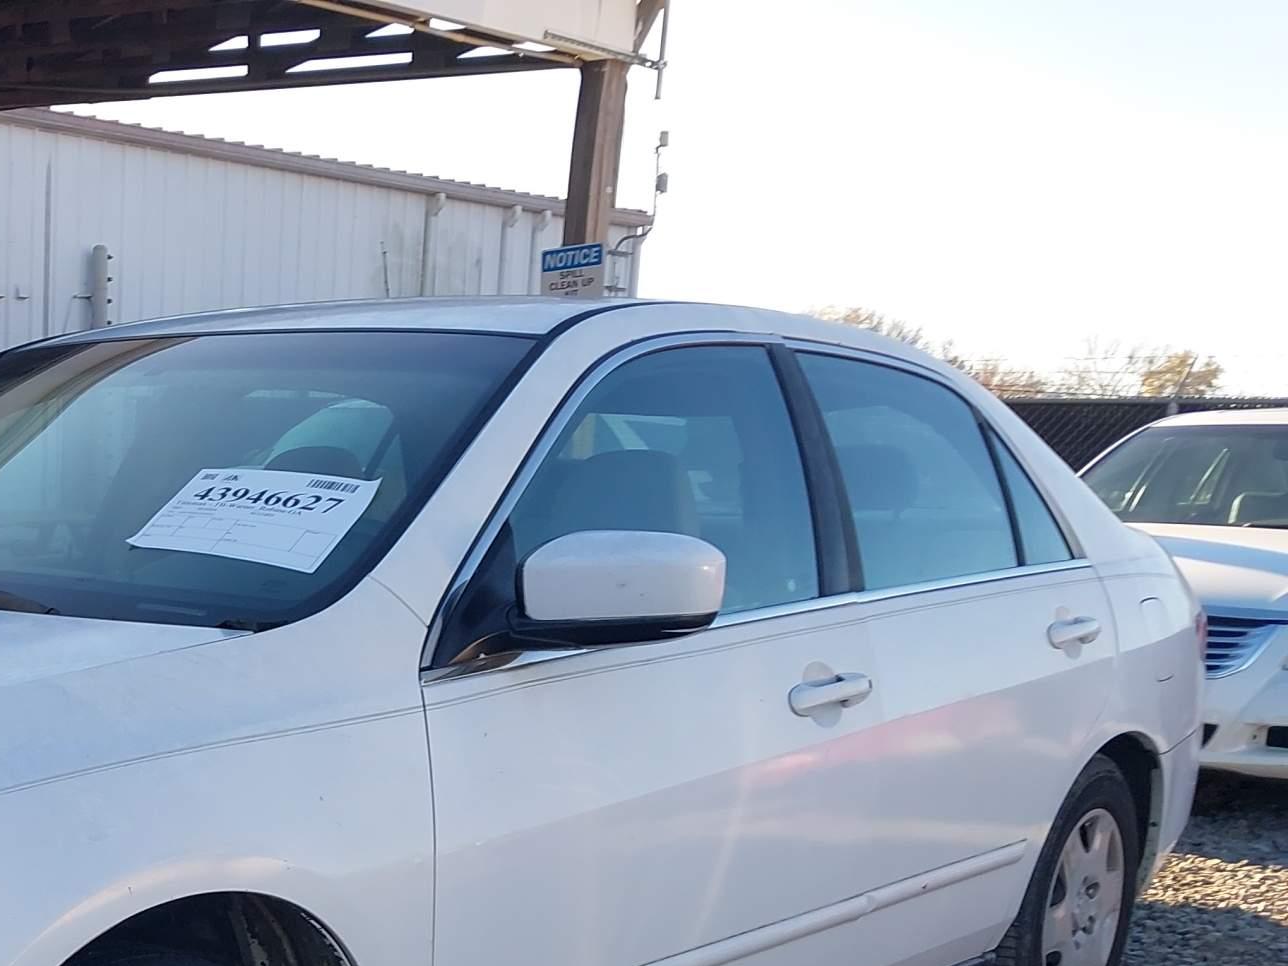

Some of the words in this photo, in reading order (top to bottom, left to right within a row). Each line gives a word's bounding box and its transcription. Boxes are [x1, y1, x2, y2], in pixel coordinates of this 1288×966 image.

[544, 247, 601, 269] NOTICE
[559, 270, 584, 279] SPILL
[549, 281, 578, 291] CLEAN
[582, 278, 594, 287] UP
[193, 486, 345, 514] 43946627
